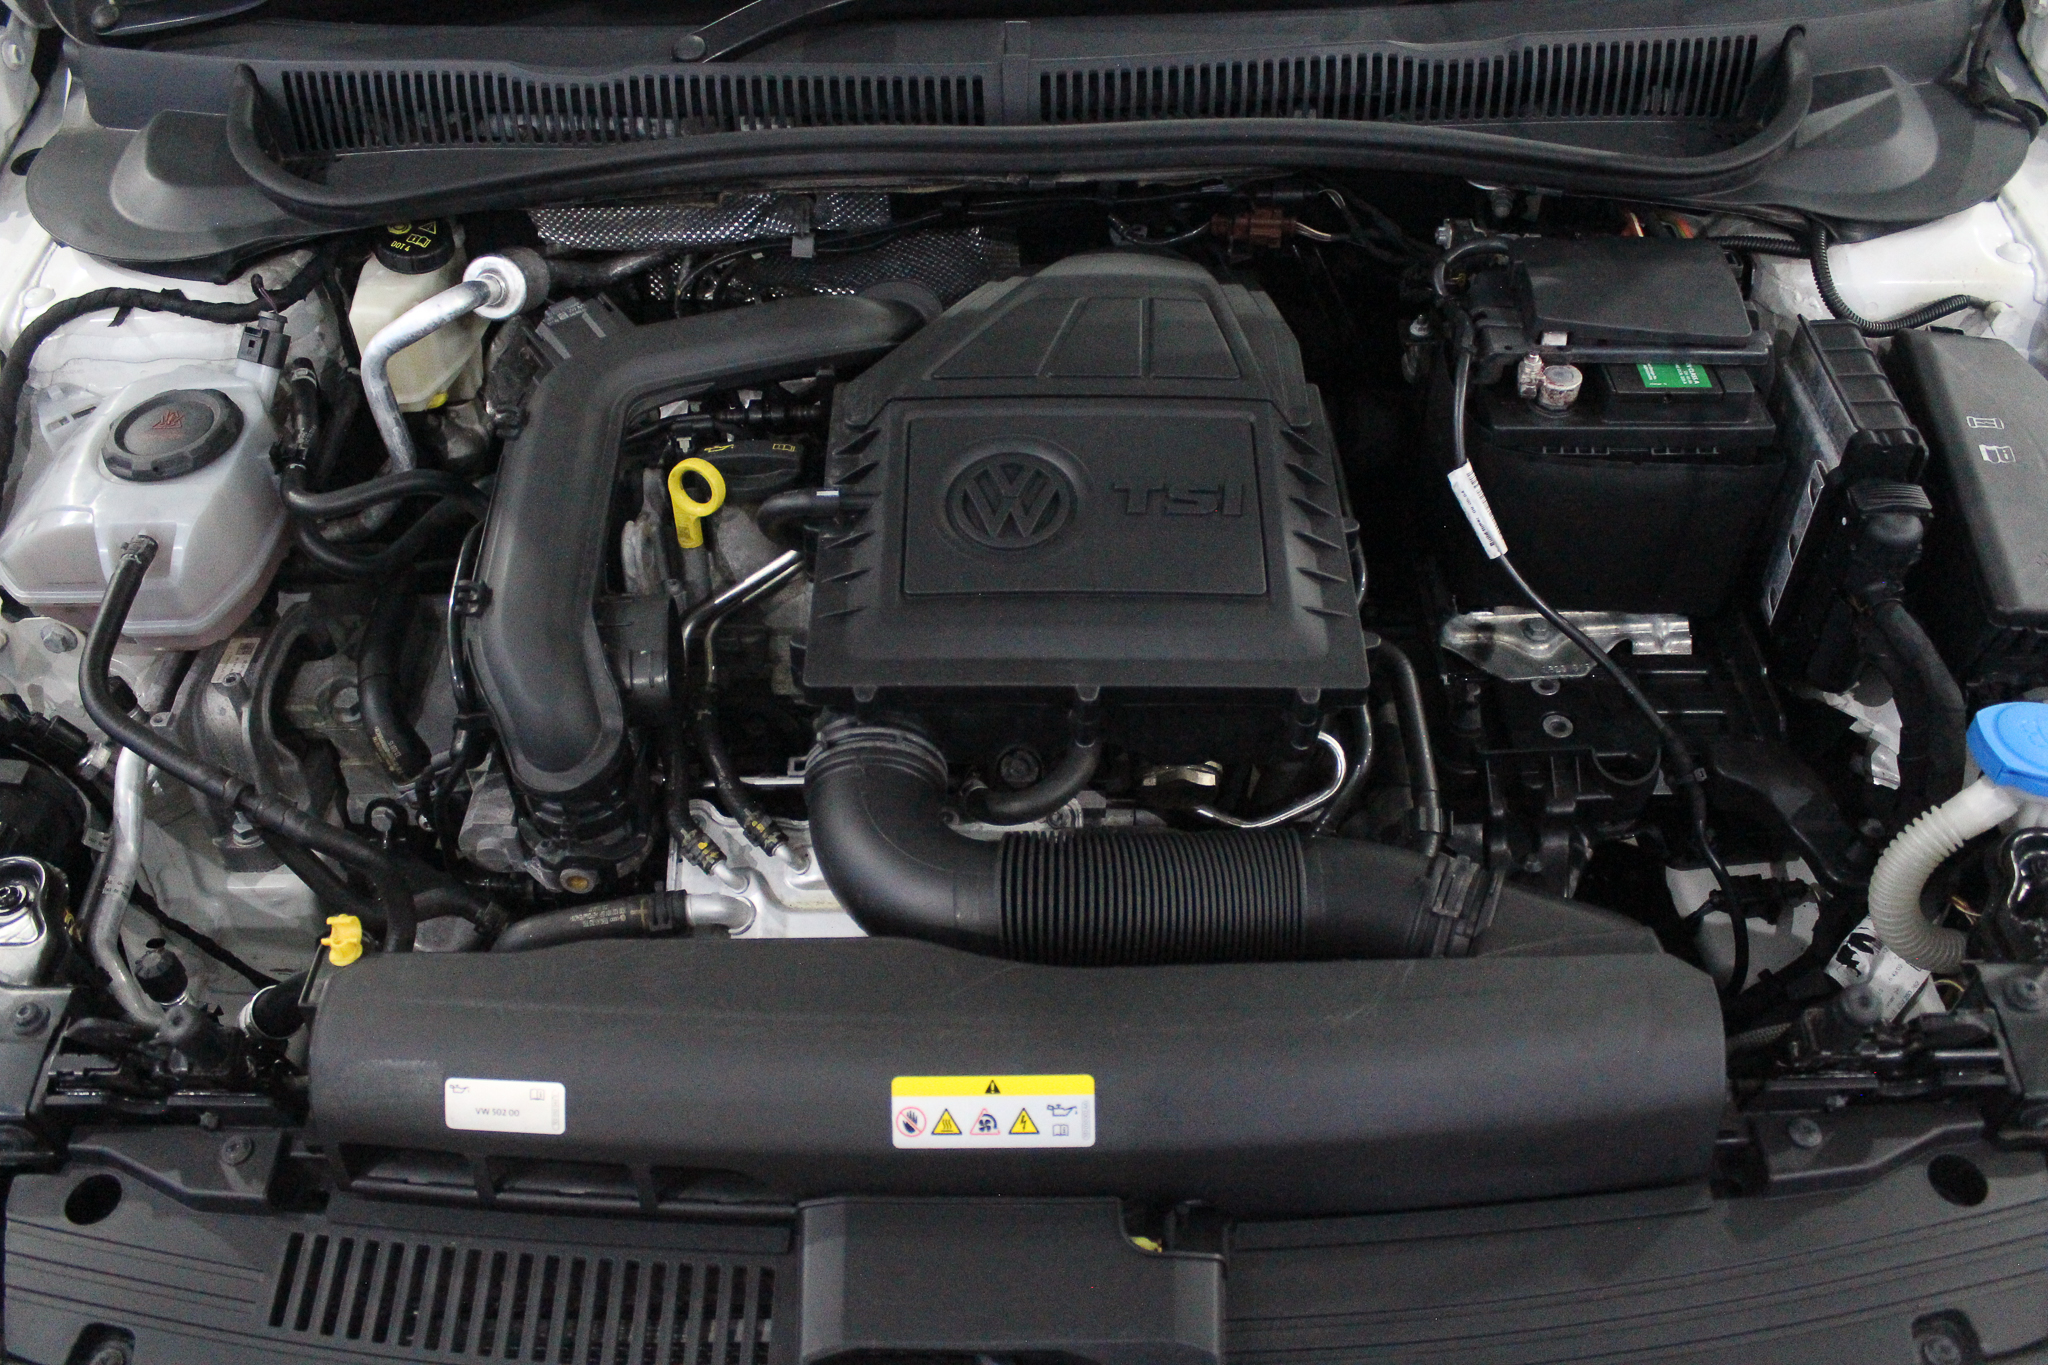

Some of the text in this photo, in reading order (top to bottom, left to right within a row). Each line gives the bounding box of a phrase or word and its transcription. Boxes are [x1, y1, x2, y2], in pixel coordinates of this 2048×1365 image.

[391, 240, 405, 250] DOT
[1112, 482, 1243, 517] TSI
[475, 1107, 520, 1117] VW 502 00
